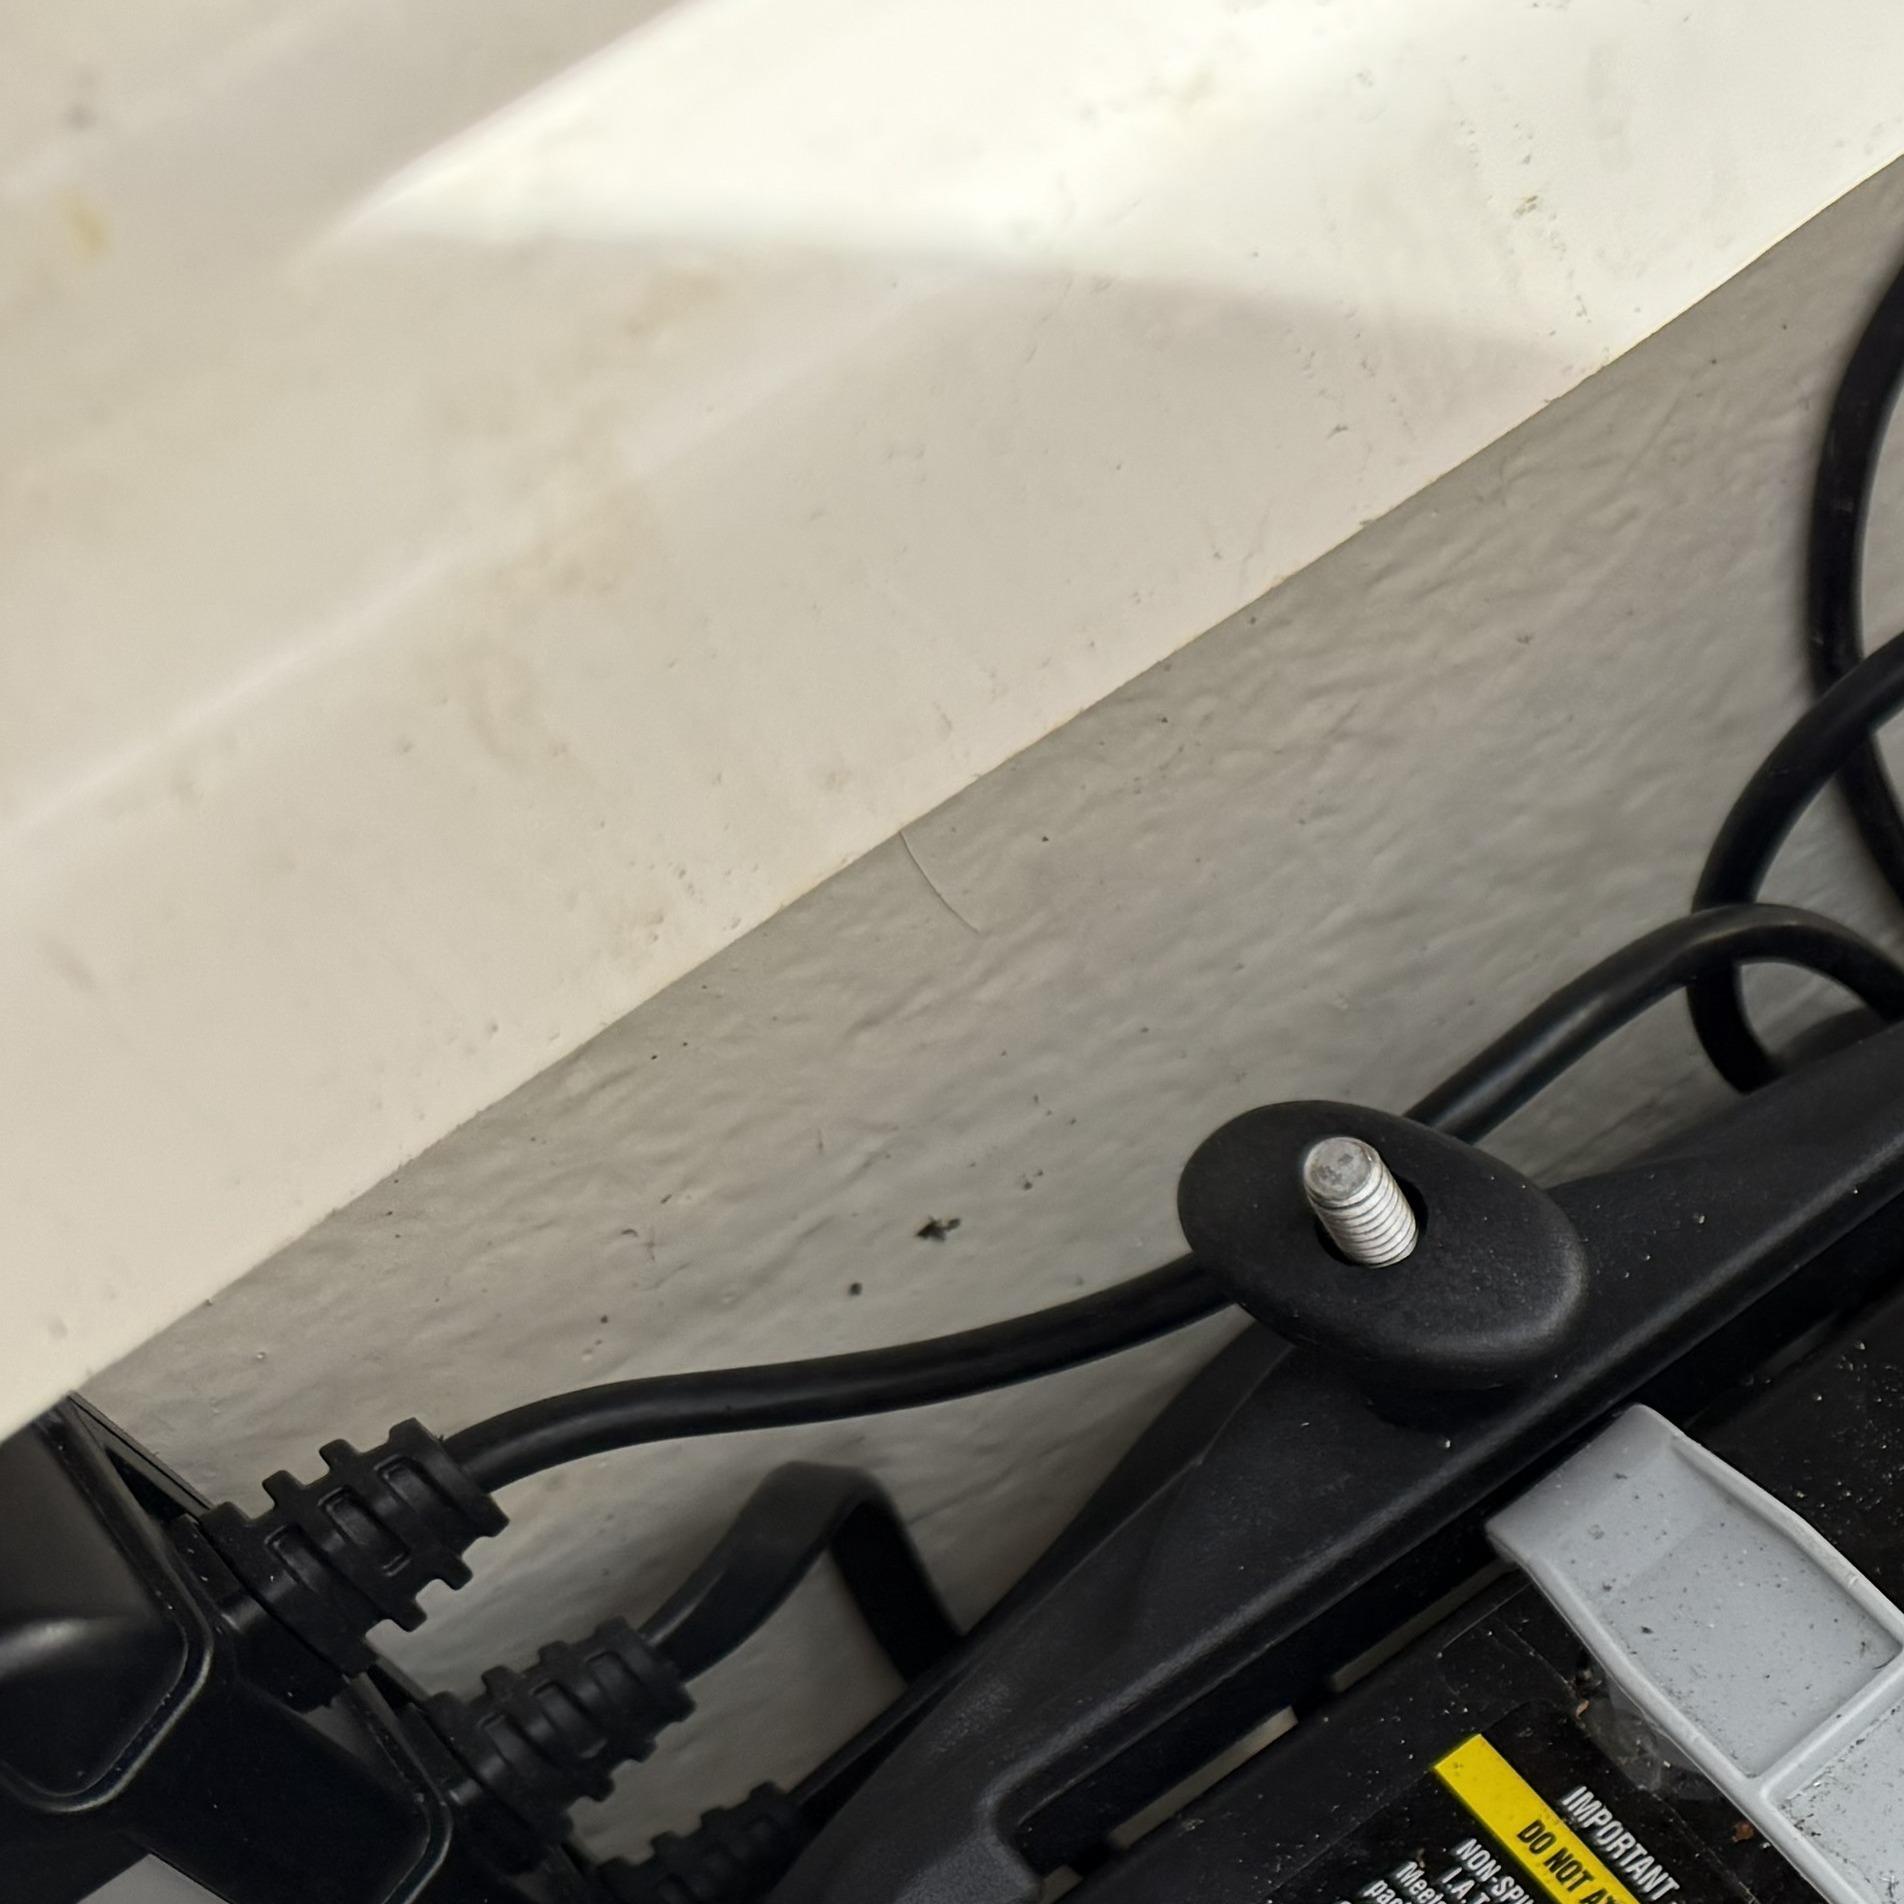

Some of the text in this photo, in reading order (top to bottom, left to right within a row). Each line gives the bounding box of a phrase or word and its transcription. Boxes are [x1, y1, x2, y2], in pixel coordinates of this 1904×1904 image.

[1515, 1818, 1558, 1857] DO
[1542, 1846, 1594, 1895] NOT
[1559, 1784, 1680, 1904] IMPORTANT
